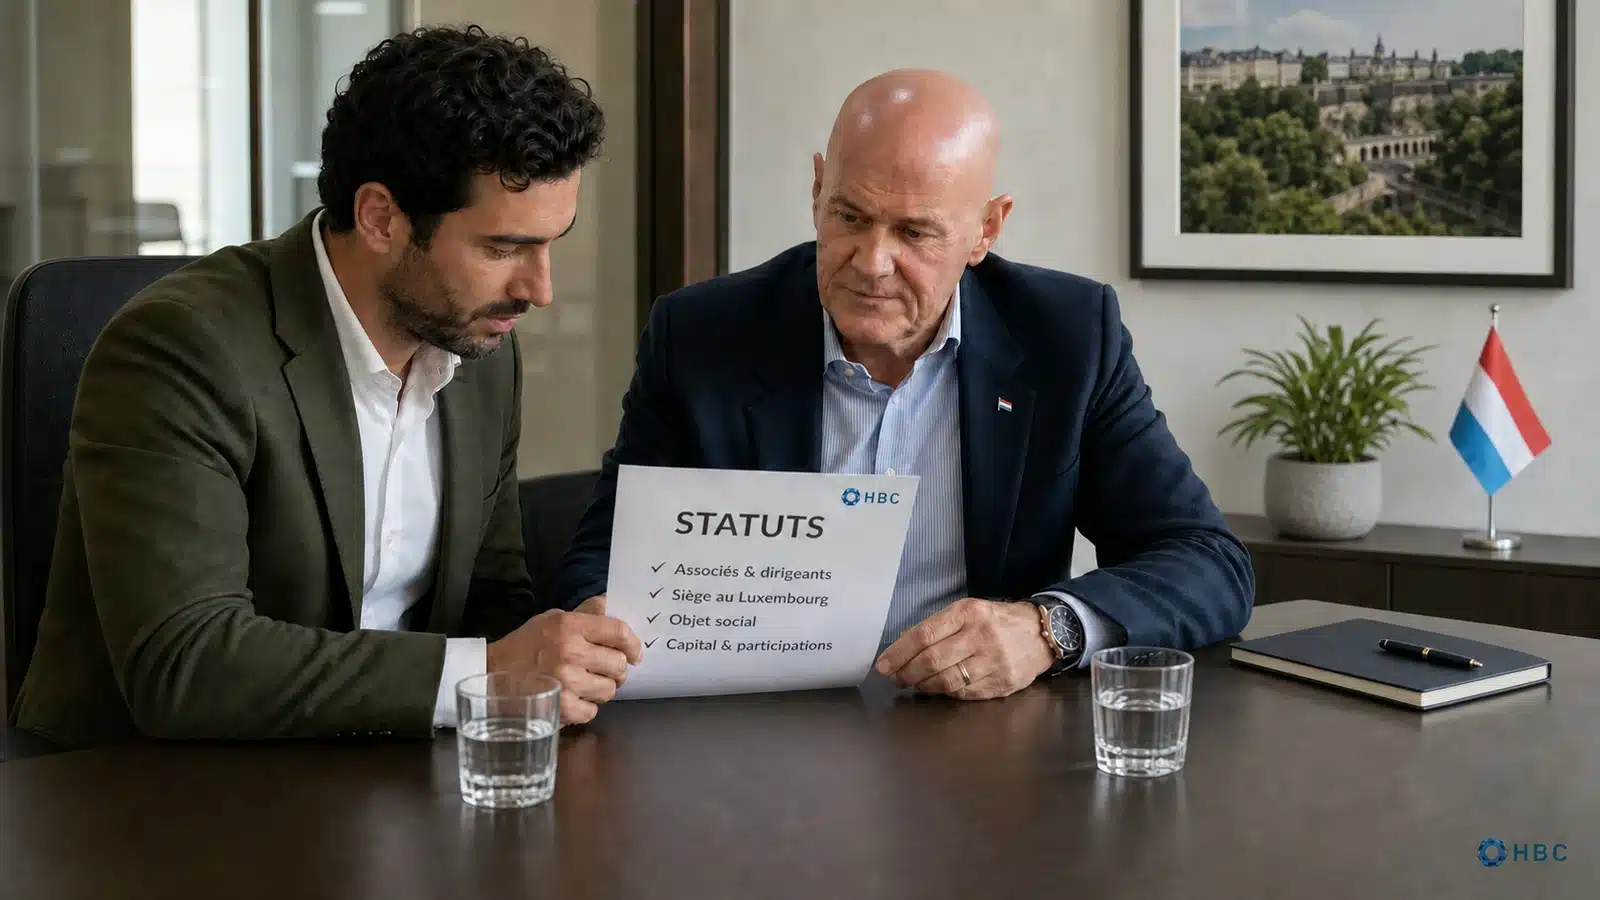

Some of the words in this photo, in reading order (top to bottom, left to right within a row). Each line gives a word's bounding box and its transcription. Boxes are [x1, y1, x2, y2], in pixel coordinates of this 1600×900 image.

[863, 491, 901, 505] HBC
[675, 511, 826, 539] STATUTS
[674, 563, 740, 578] Associés
[744, 566, 756, 578] &
[760, 566, 833, 582] dirigeants
[672, 588, 712, 603] Siège
[716, 592, 734, 603] au
[739, 591, 829, 607] Luxembourg
[669, 614, 711, 628] Objet
[715, 615, 757, 628] social
[666, 638, 717, 652] Capital
[721, 639, 733, 651] &
[737, 639, 833, 653] participations
